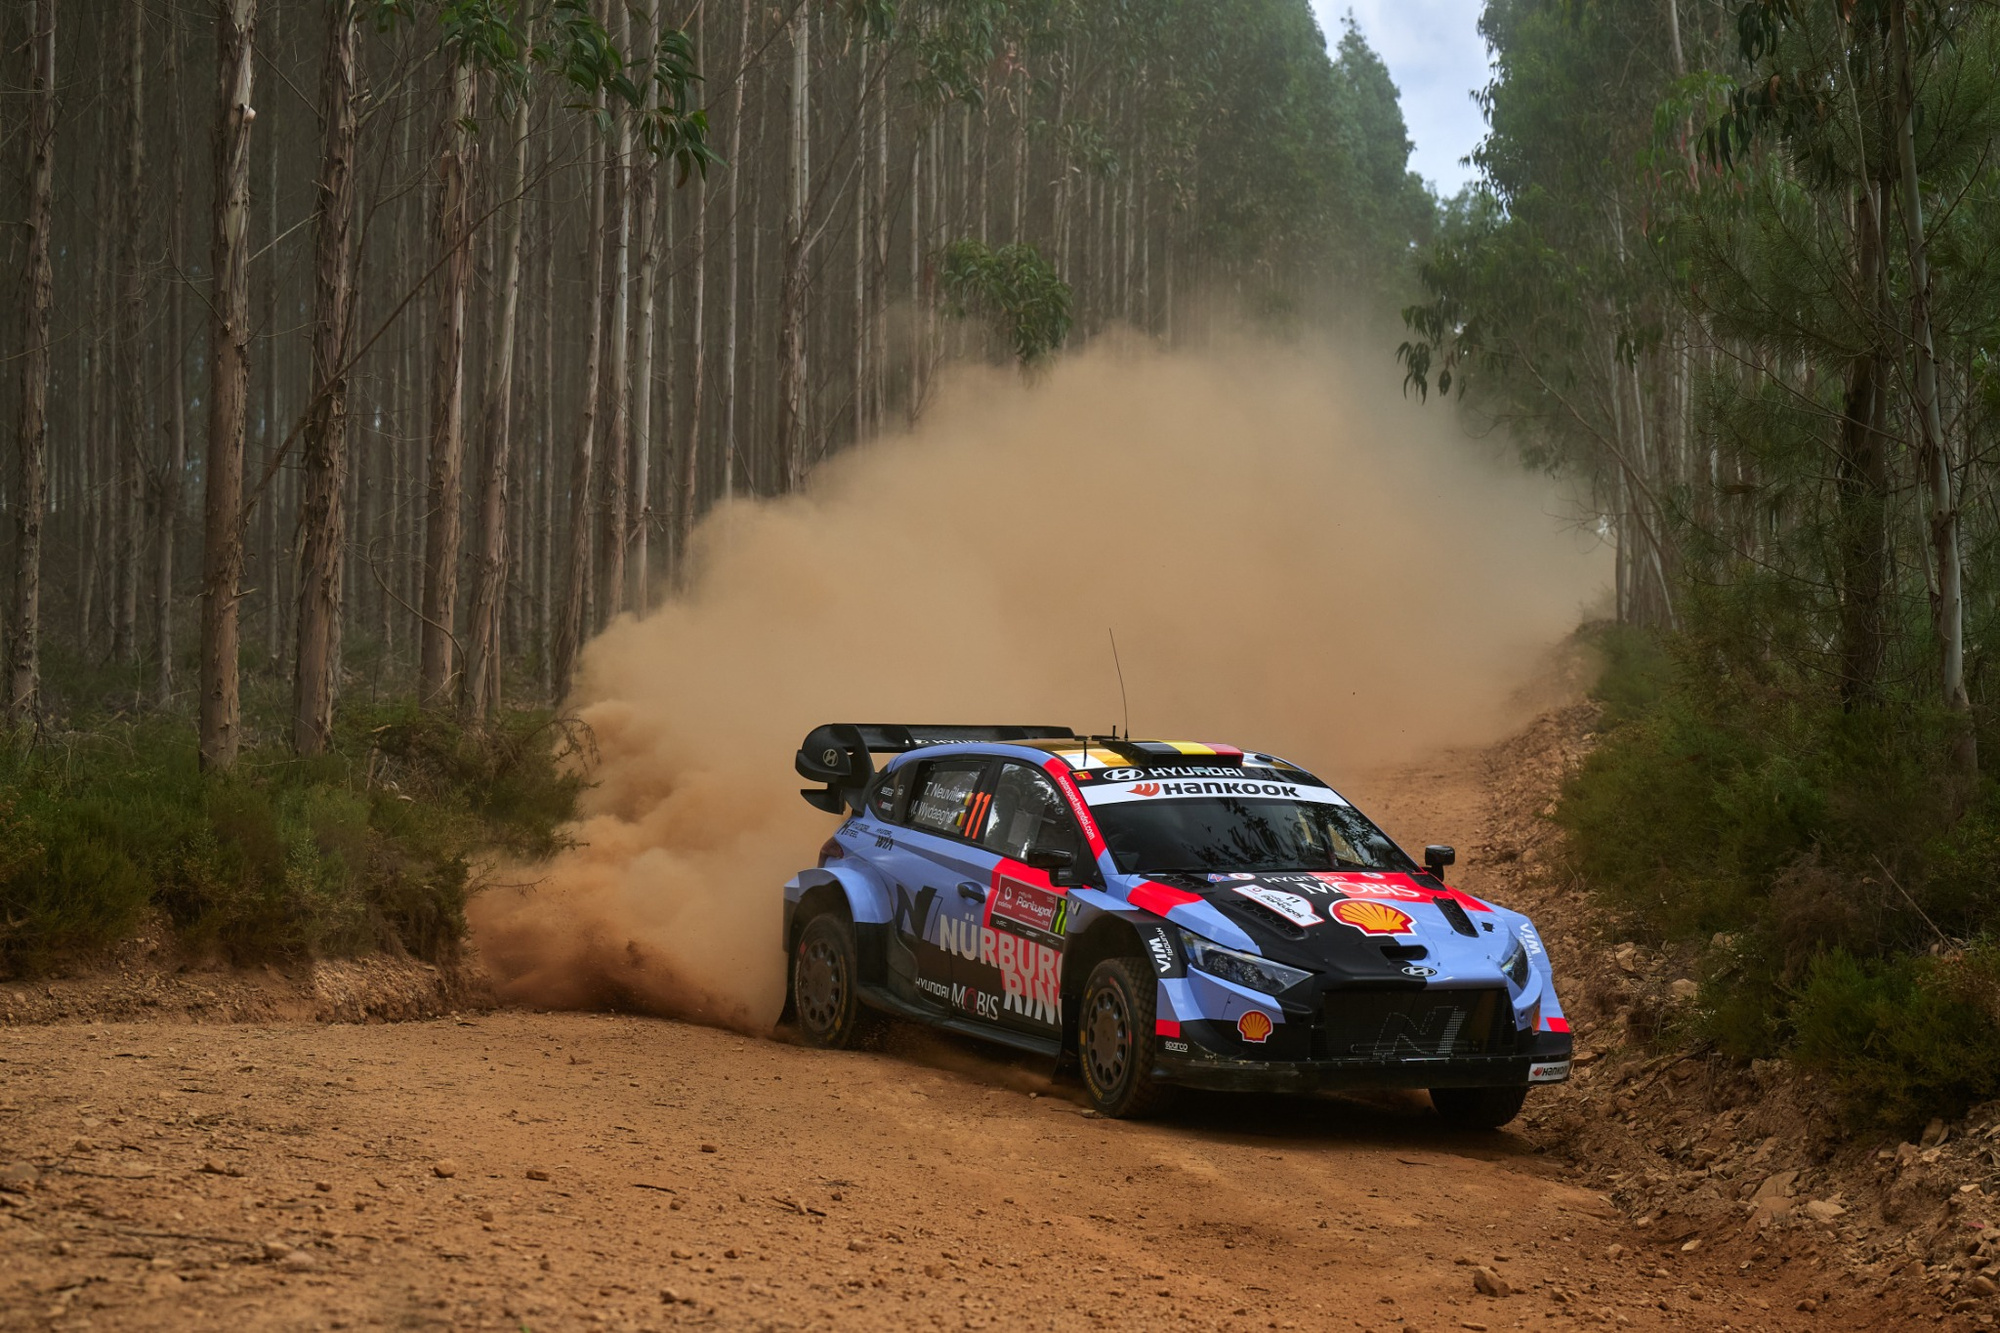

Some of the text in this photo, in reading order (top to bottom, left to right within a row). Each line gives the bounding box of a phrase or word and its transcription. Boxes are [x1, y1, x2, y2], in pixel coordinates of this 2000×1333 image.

[1148, 766, 1245, 777] HYUNDAI
[924, 781, 933, 796] T.
[931, 783, 962, 802] Neuville
[964, 791, 992, 840] 11
[1058, 776, 1096, 841] motorsport.hyundai.com
[1262, 875, 1348, 884] HYUNDAI
[1296, 881, 1420, 897] MOBIS
[1016, 896, 1053, 918] Portugal
[1067, 901, 1082, 916] N
[1148, 937, 1172, 973] WIA
[916, 977, 999, 1021] HYUNDAI MOBIS
[1003, 968, 1063, 1027] RIN
[1164, 1040, 1189, 1053] sparco
